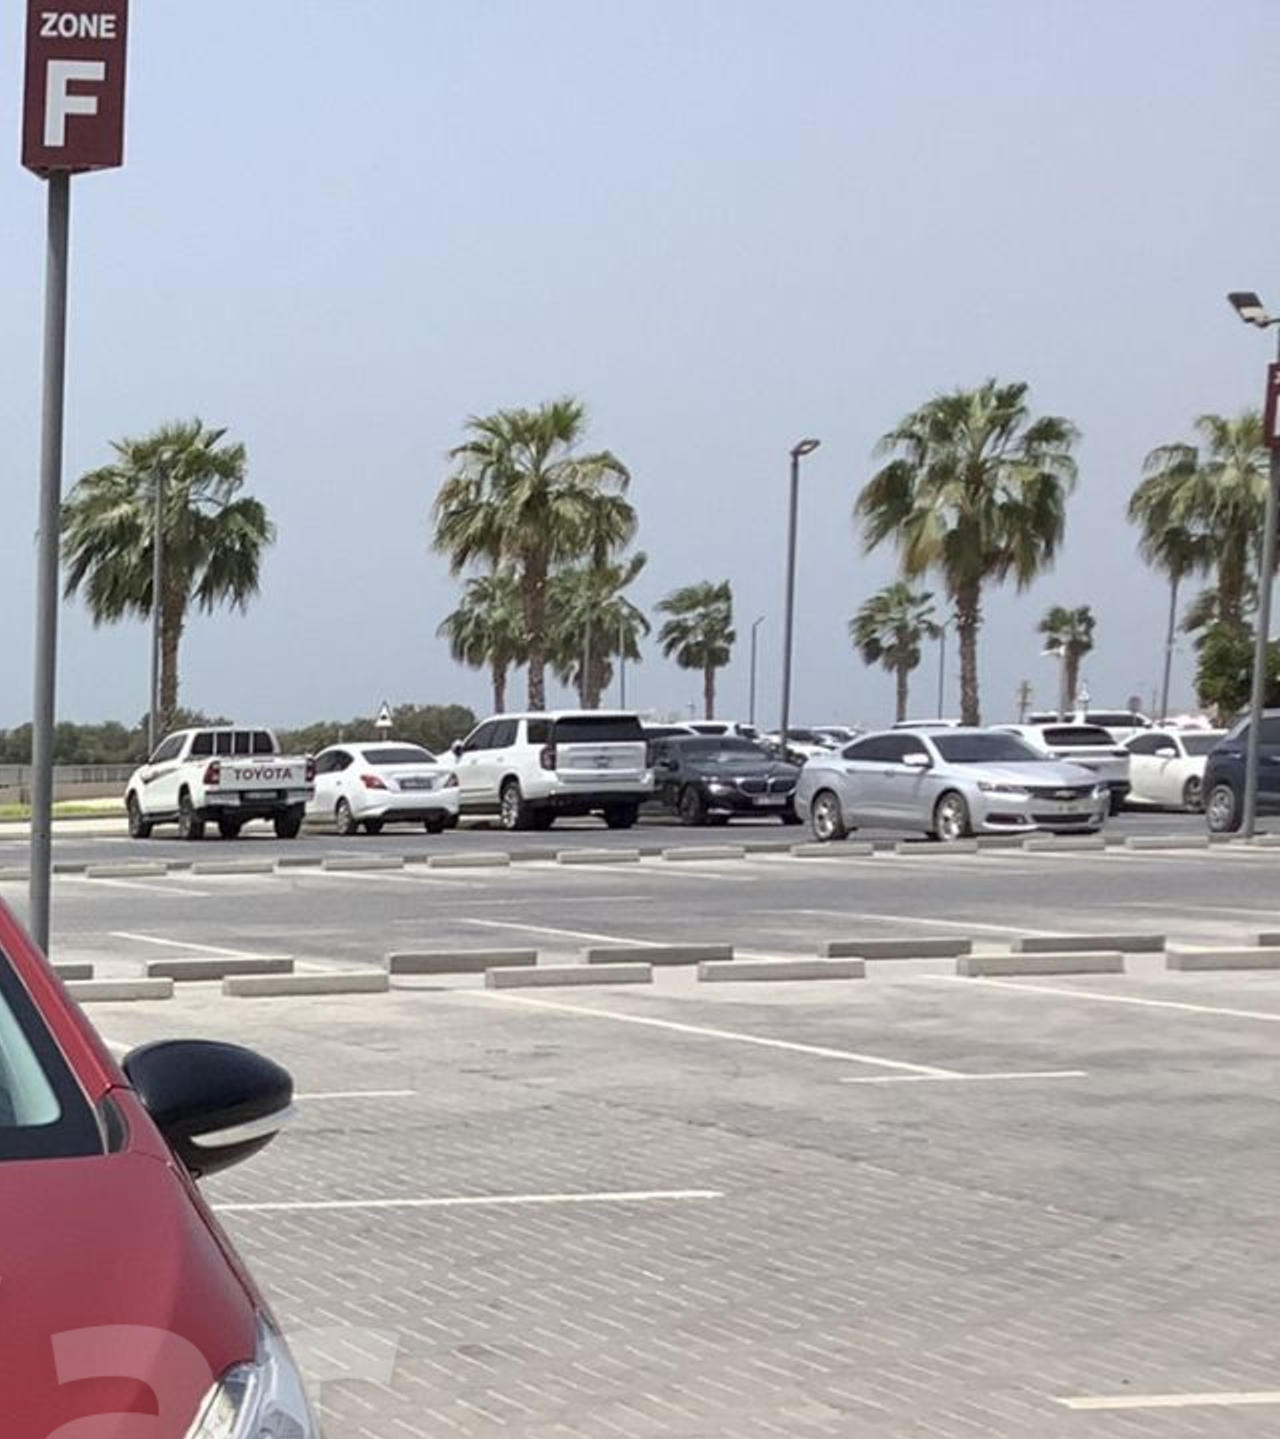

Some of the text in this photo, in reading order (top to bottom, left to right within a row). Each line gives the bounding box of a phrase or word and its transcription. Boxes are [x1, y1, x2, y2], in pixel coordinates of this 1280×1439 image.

[40, 12, 117, 39] ZONE
[43, 59, 106, 147] F
[234, 767, 293, 780] TOYOTA
